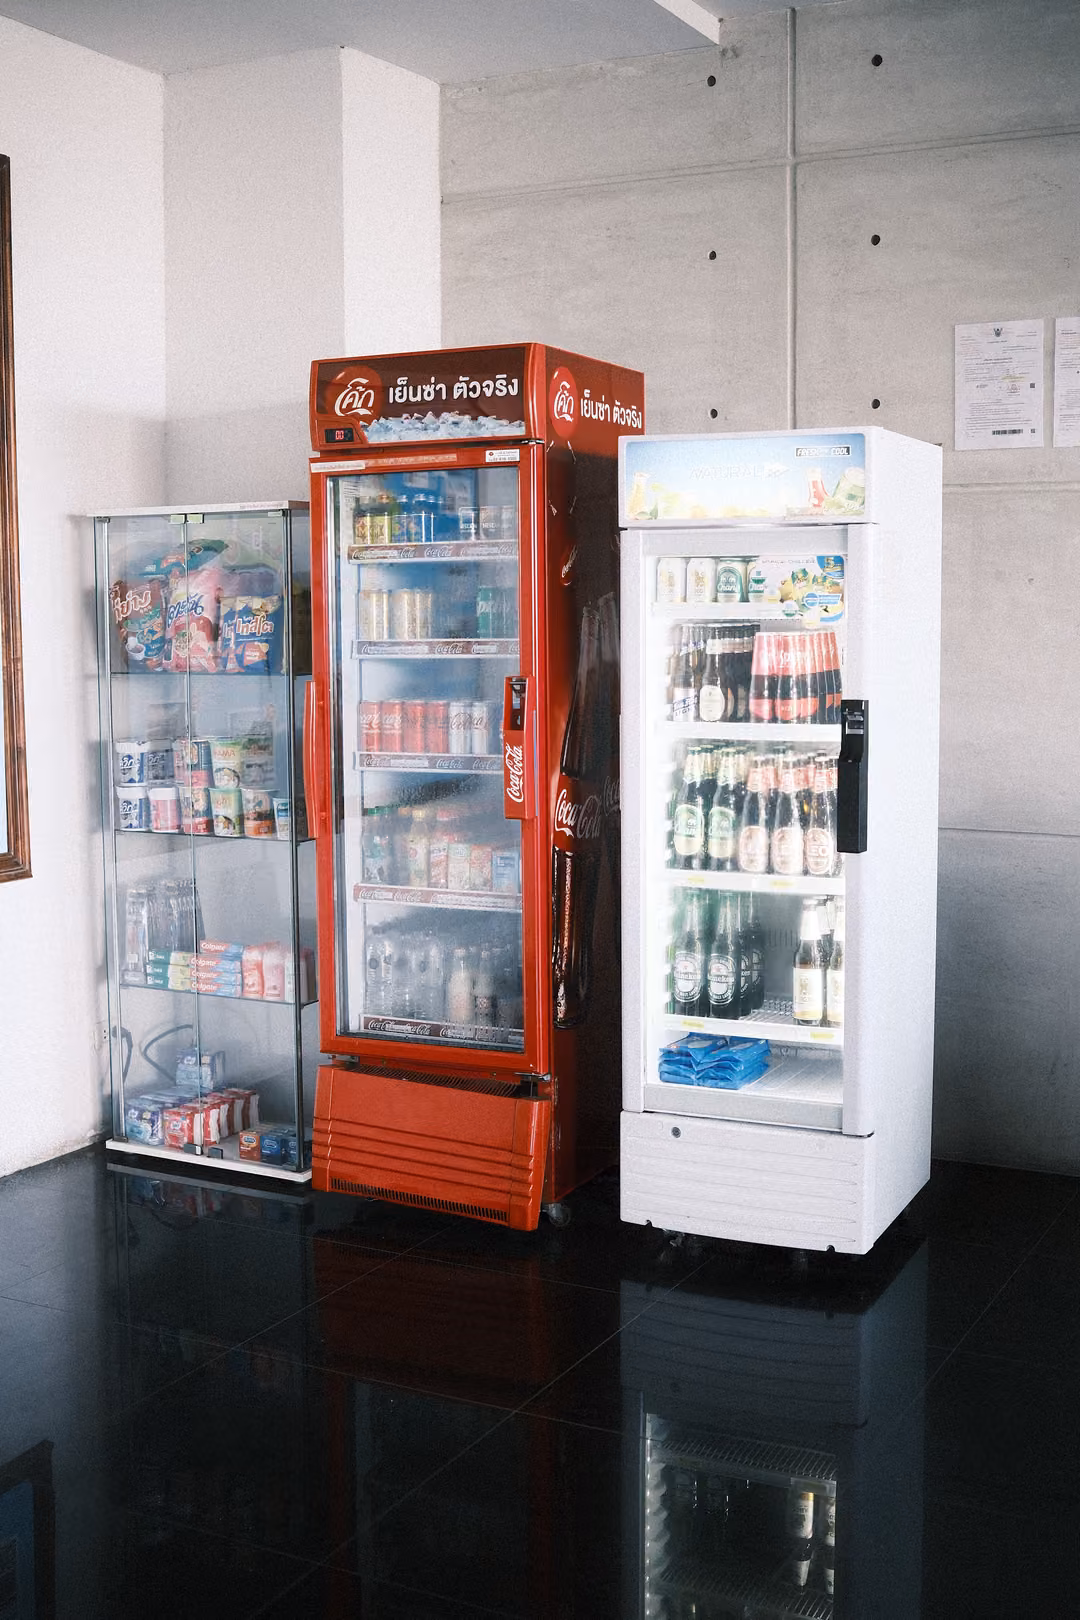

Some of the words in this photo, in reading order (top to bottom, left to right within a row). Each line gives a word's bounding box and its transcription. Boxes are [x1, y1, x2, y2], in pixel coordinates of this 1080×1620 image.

[389, 376, 447, 404] เย็นซ่า
[453, 374, 519, 399] ตัวจริง
[580, 389, 611, 422] เย็นซ่า
[613, 400, 642, 429] ตัวจริง
[505, 742, 524, 803] Coca-Cola
[201, 942, 226, 951] Colgate
